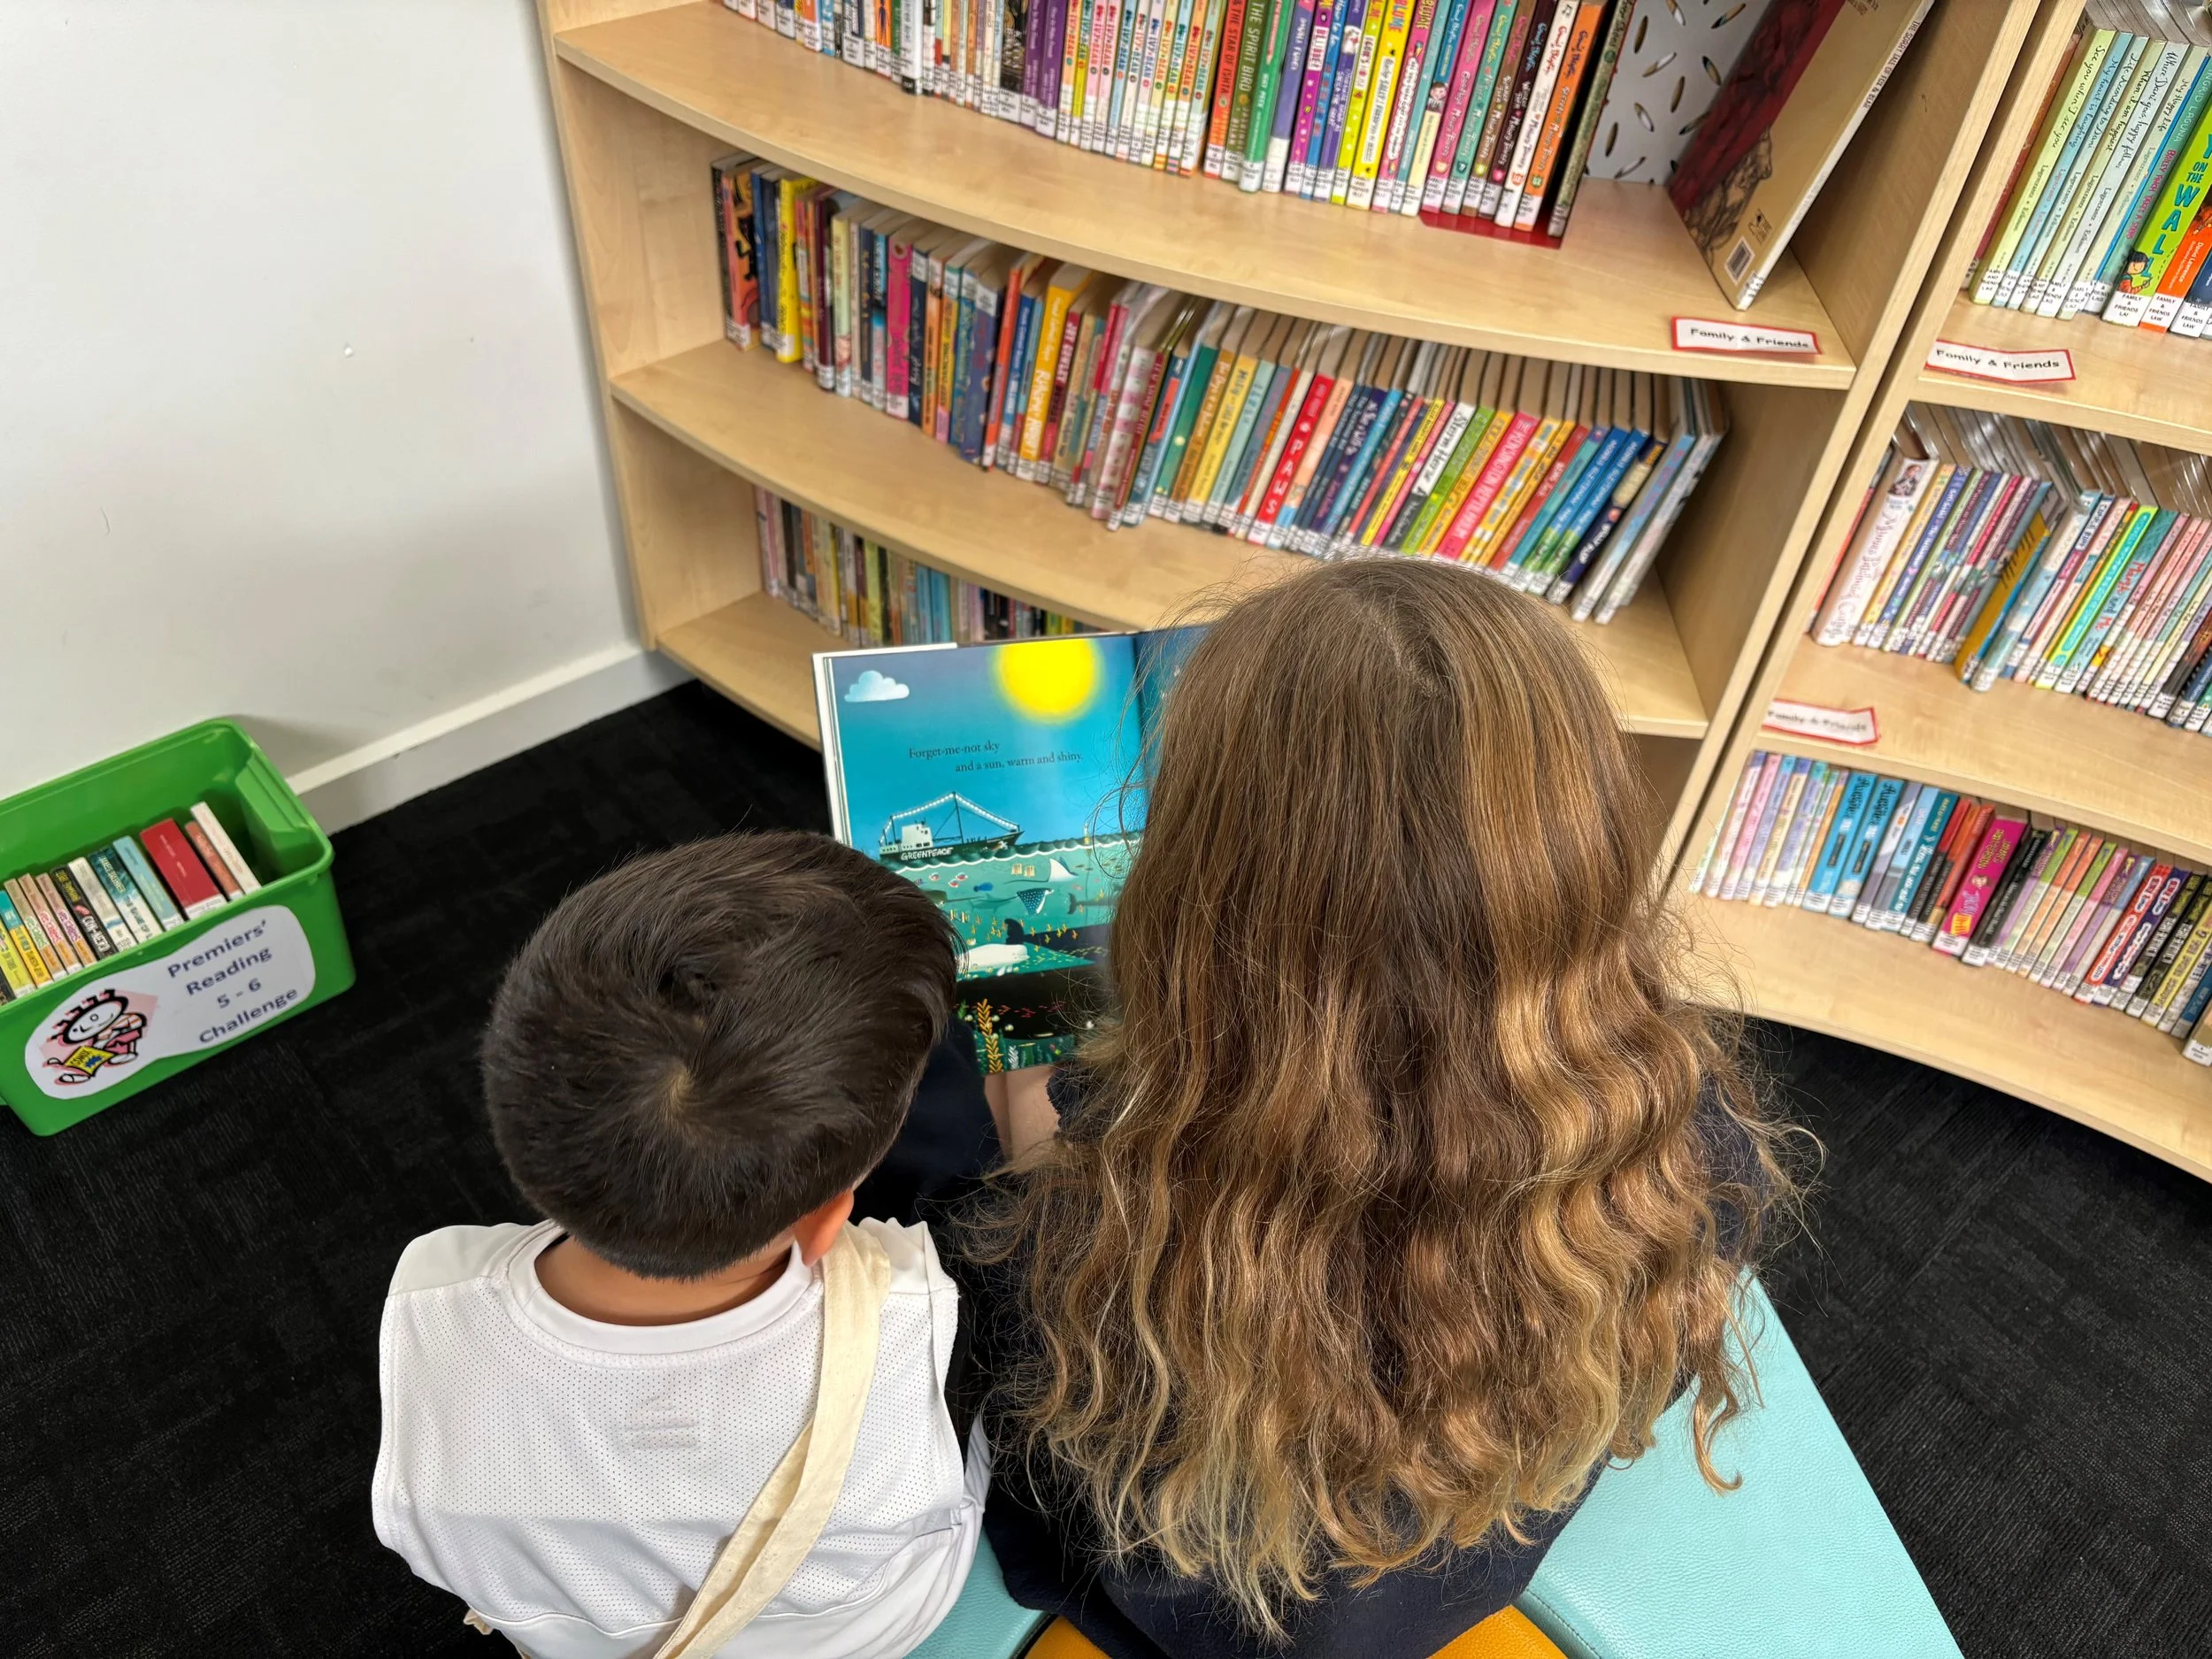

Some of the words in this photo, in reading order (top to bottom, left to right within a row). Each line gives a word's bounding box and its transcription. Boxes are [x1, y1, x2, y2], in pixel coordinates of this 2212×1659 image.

[1249, 3, 1263, 22] THE
[1909, 20, 1920, 32] THE
[1226, 27, 1238, 51] STAR
[1245, 28, 1259, 62] SPIRIT
[1895, 31, 1911, 54] SORRY
[1224, 54, 1234, 65] OF
[1888, 53, 1900, 65] TALE
[2092, 47, 2105, 61] See
[2124, 53, 2138, 73] Life
[2161, 52, 2177, 76] Where
[1883, 65, 1891, 75] OF
[2080, 62, 2093, 81] you
[2102, 57, 2118, 75] My
[1221, 69, 1232, 94] ISHTA
[1239, 65, 1253, 91] BIRD
[1876, 74, 1886, 87] FOX
[2134, 71, 2151, 93] When
[2149, 77, 2168, 101] Dani
[2176, 79, 2189, 93] My
[2071, 82, 2085, 104] when
[2094, 79, 2109, 101] heart
[2101, 75, 2127, 115] According
[2122, 105, 2131, 118] am
[2163, 95, 2182, 116] Happy
[2061, 116, 2070, 131] see
[2069, 113, 2093, 148] laughing
[2127, 120, 2148, 143] happy
[2158, 118, 2170, 132] Life
[2172, 104, 2196, 142] LAGUNA
[2050, 131, 2062, 148] you
[2088, 125, 2102, 148] Dani
[2101, 120, 2125, 150] happiest
[2157, 147, 2175, 173] BAILEY
[2193, 161, 2208, 173] ON
[2147, 171, 2163, 194] FINCH
[2185, 172, 2204, 184] THE
[2136, 192, 2152, 215] TAKES
[2124, 219, 2139, 241] STAND
[2140, 183, 2200, 279] WALL
[2193, 242, 2204, 257] David
[2178, 255, 2196, 283] Lawrence
[2156, 296, 2176, 304] FAMILY
[2189, 303, 2209, 311] FAMILY
[2149, 308, 2170, 317] FRIENDS
[2181, 315, 2203, 324] FRIENDS
[1690, 327, 1736, 342] Family
[1740, 334, 1751, 344] &
[1756, 336, 1809, 349] Friends
[1936, 349, 1981, 365] Family
[1987, 357, 1998, 367] &
[2003, 360, 2060, 371] Friends
[909, 743, 981, 761] Forget-me-not
[984, 740, 1001, 753] sky
[956, 759, 974, 772] and
[1007, 757, 1035, 767] warm
[1036, 752, 1056, 764] and
[1057, 750, 1084, 764] shiny.
[901, 846, 954, 861] GREENPEACE
[167, 918, 266, 979] Premiers'
[186, 947, 273, 996] Reading
[217, 994, 231, 1009] 5
[248, 977, 262, 992] 6
[199, 988, 298, 1043] Challenge
